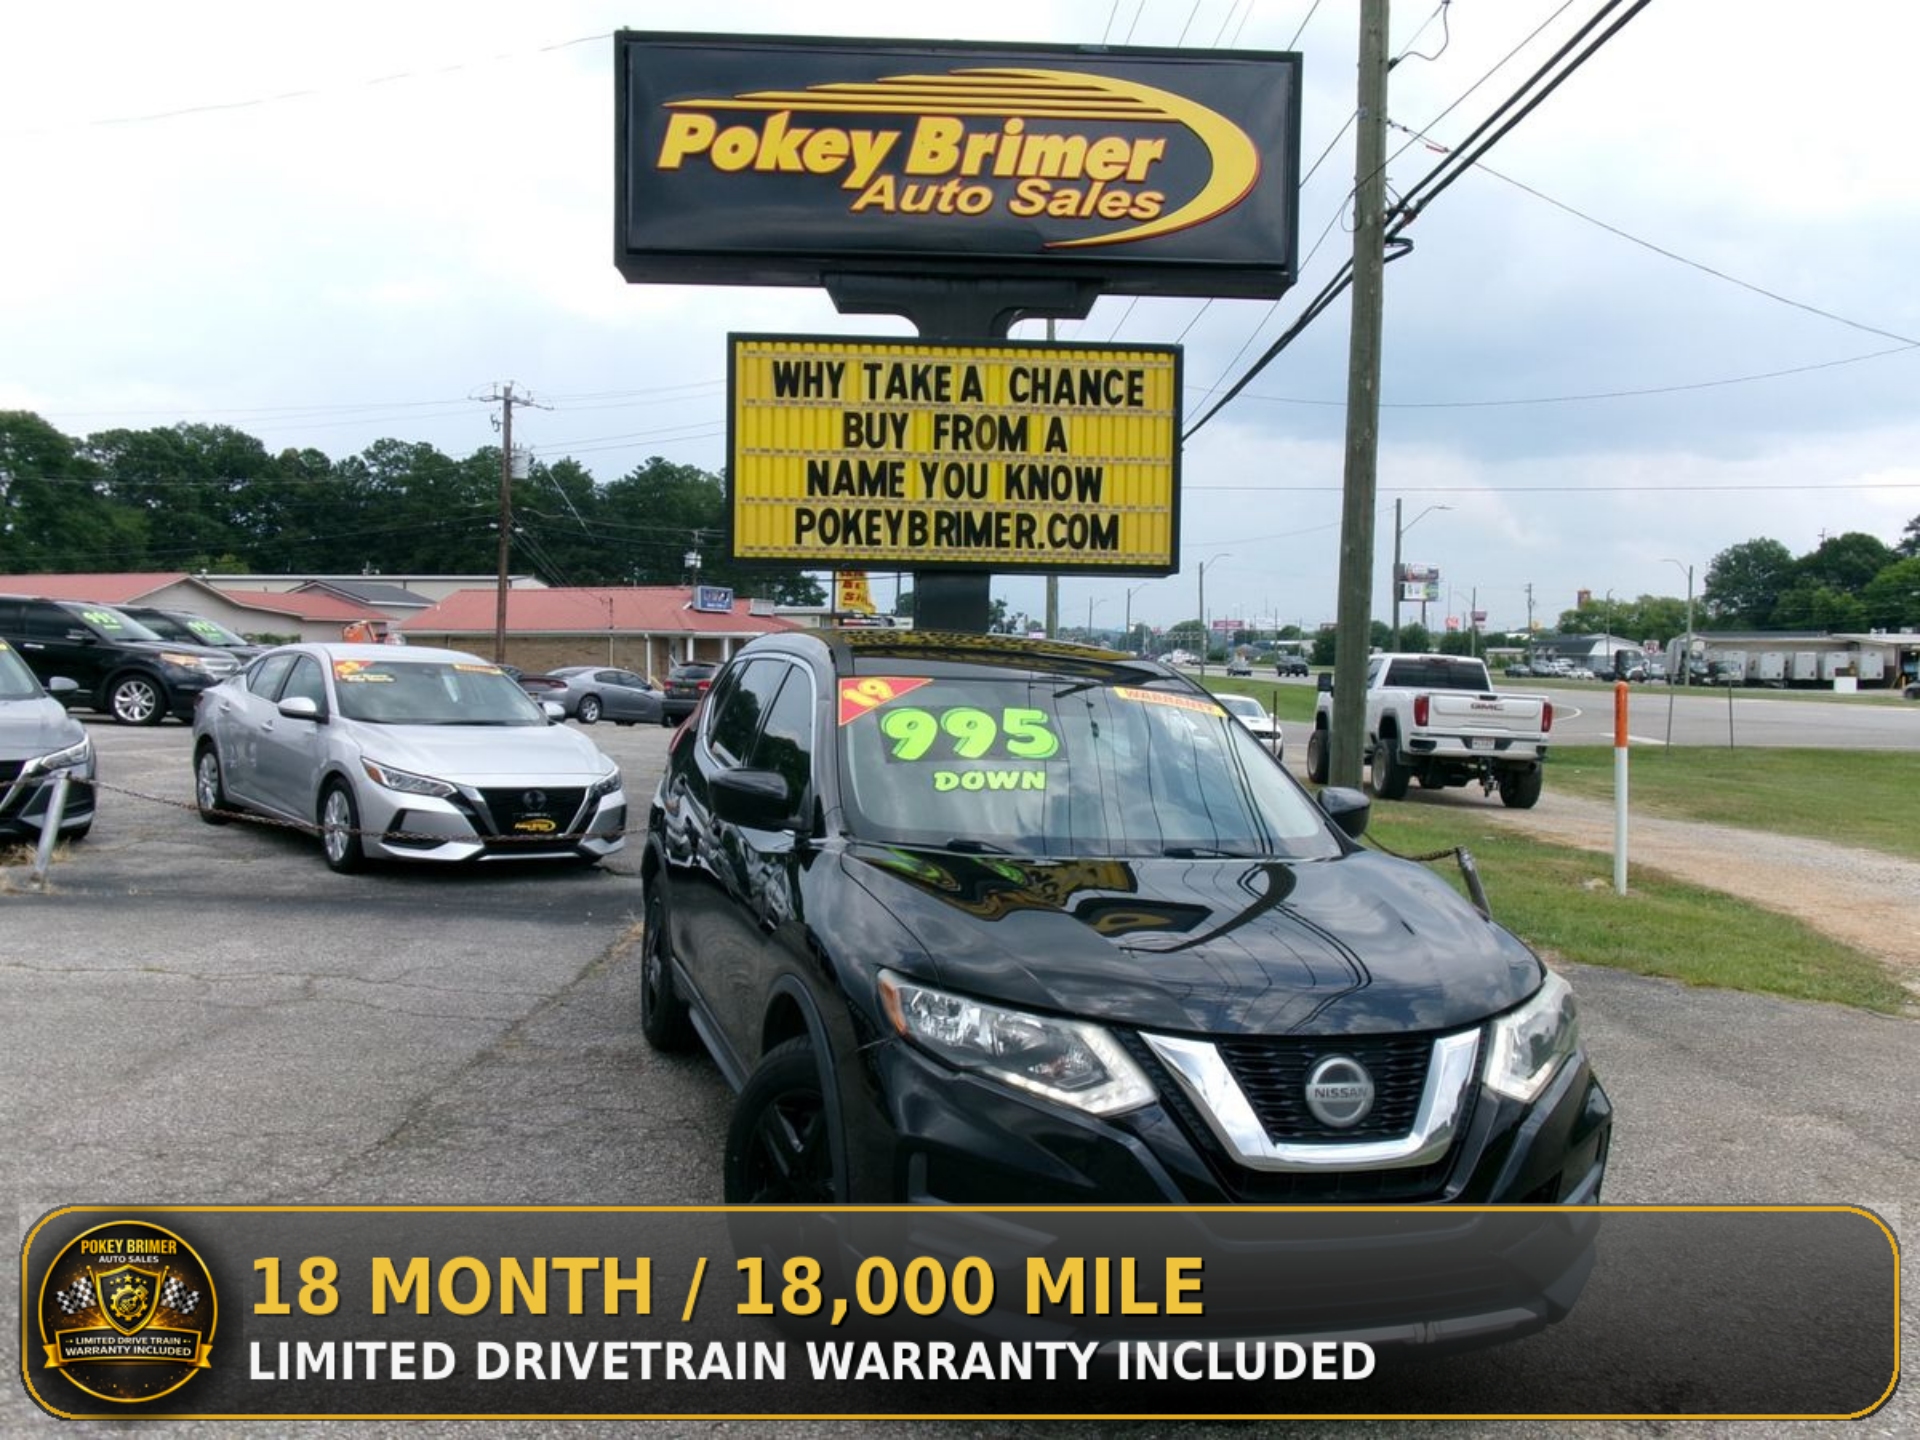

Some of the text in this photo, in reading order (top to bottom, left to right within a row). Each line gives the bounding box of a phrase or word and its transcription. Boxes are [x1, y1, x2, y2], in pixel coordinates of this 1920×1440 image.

[657, 110, 1165, 190] Pokey Brimer
[850, 175, 1164, 220] Auto Sales
[772, 360, 1144, 407] WHY TAKE A CHANCE
[843, 411, 1067, 453] BUY FROM A
[807, 460, 1103, 503] NAME YOU KNOW
[795, 507, 1119, 550] POKEYBRIMER.COM
[842, 677, 894, 708] 19
[1471, 703, 1504, 711] GMC
[881, 707, 1059, 761] 995
[934, 770, 1046, 792] DOWN
[1314, 1087, 1368, 1099] NISSAN
